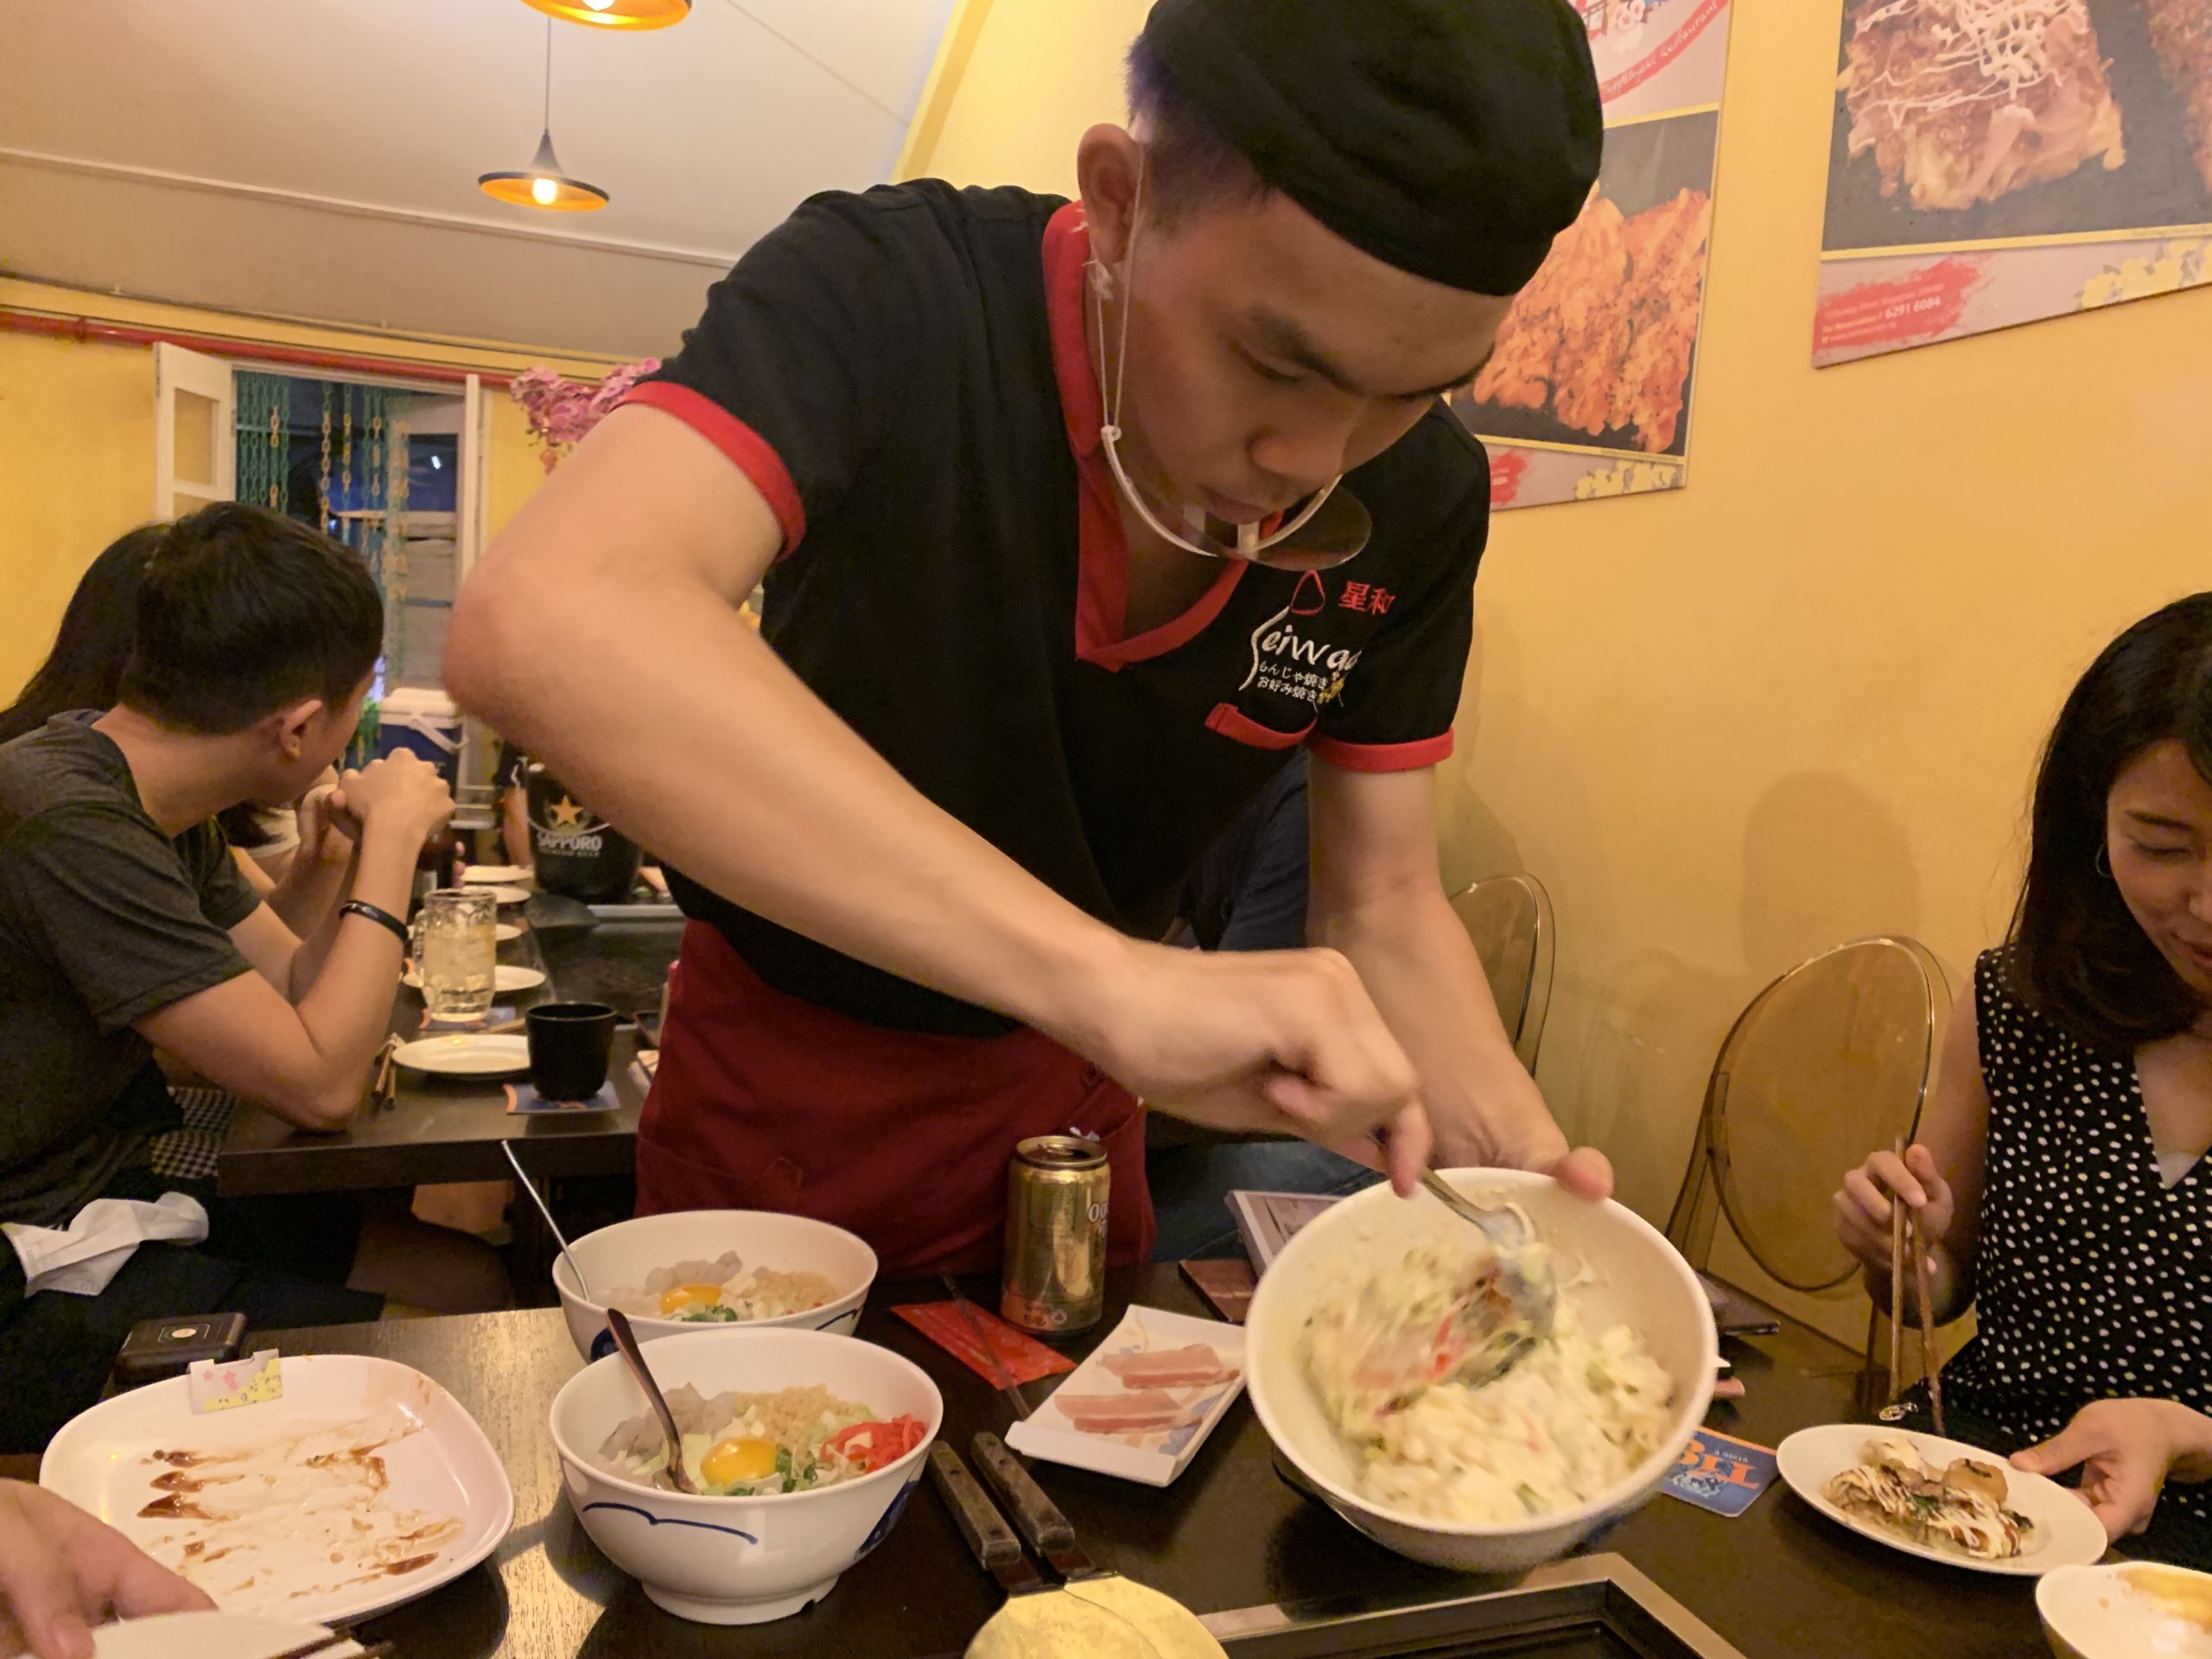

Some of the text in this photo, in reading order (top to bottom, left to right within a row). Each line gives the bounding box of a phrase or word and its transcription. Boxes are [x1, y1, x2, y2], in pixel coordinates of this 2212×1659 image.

[1885, 302, 1910, 319] 6291
[1913, 296, 1942, 313] 6084
[1338, 580, 1396, 615] 星和
[1257, 676, 1318, 702] お好み焼き
[1259, 660, 1329, 690] もんじゃ焼き
